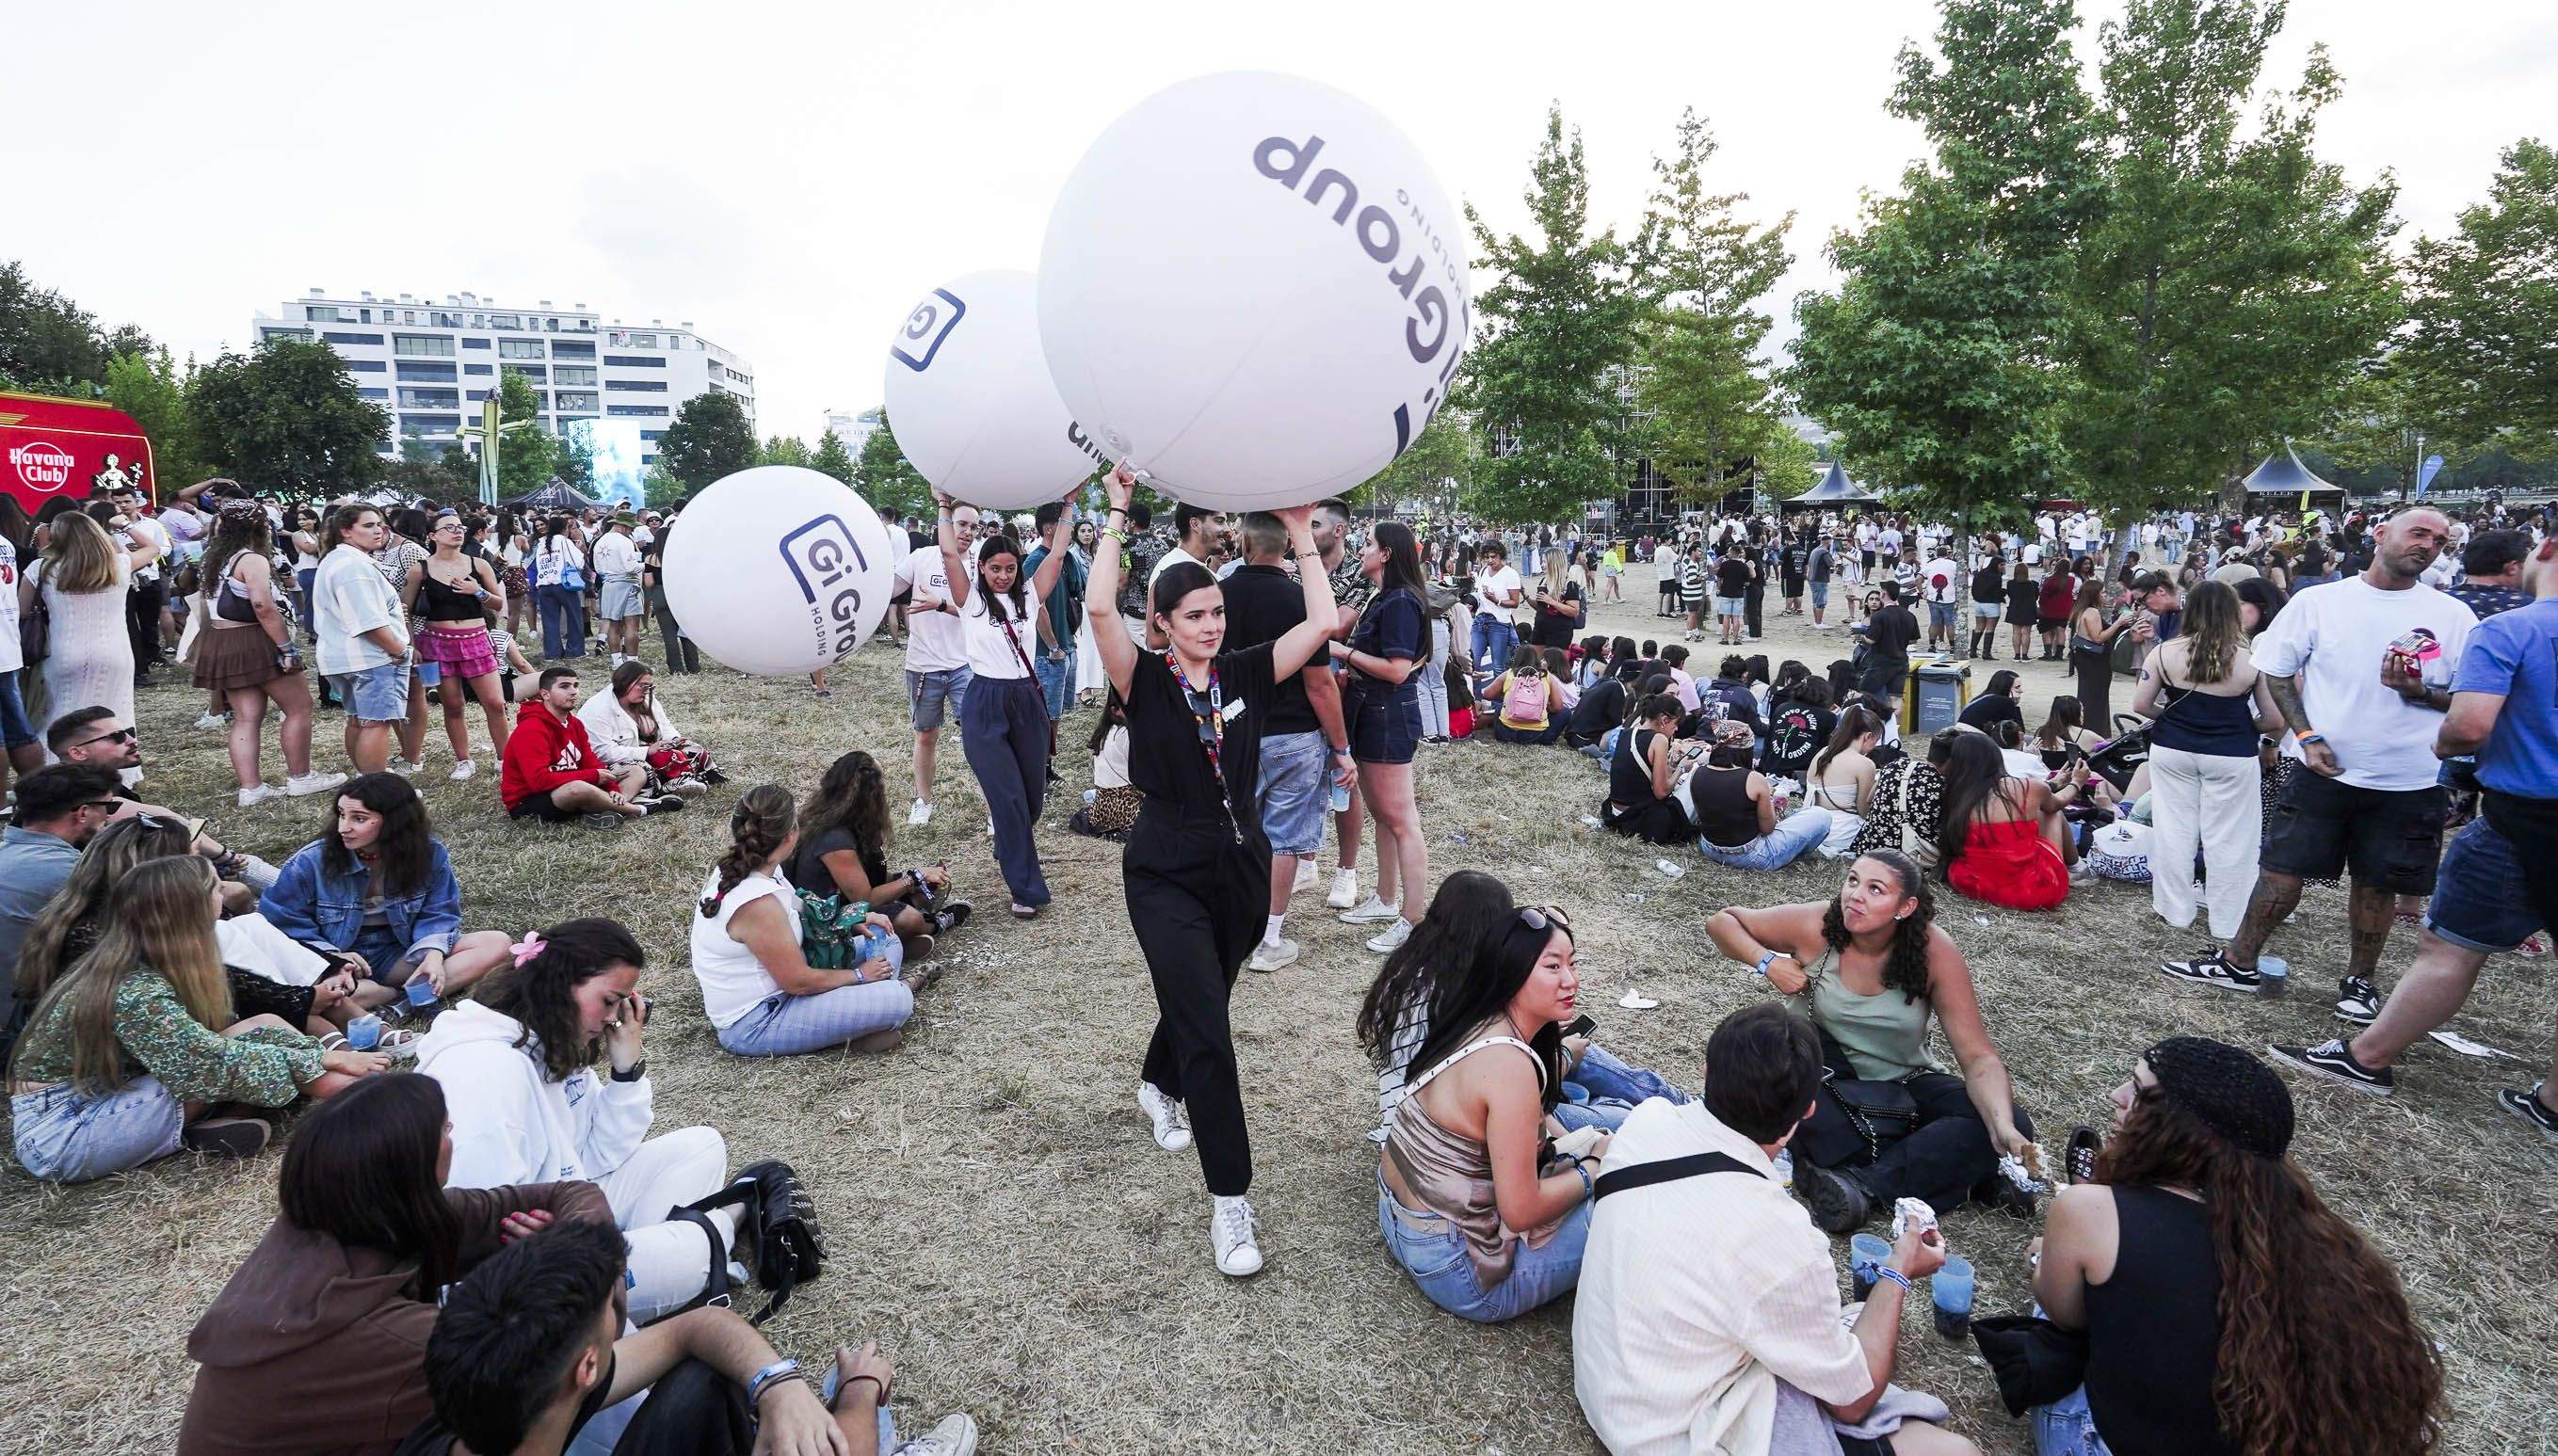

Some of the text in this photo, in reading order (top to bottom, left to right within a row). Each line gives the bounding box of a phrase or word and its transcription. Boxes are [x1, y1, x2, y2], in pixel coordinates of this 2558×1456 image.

[1253, 135, 1448, 364] Group
[1397, 188, 1462, 299] HOLDING
[9, 448, 74, 467] Havana
[25, 465, 63, 483] Club
[808, 538, 853, 588] Gi
[811, 606, 827, 656] HOLDING
[1781, 709, 1800, 718] POVO
